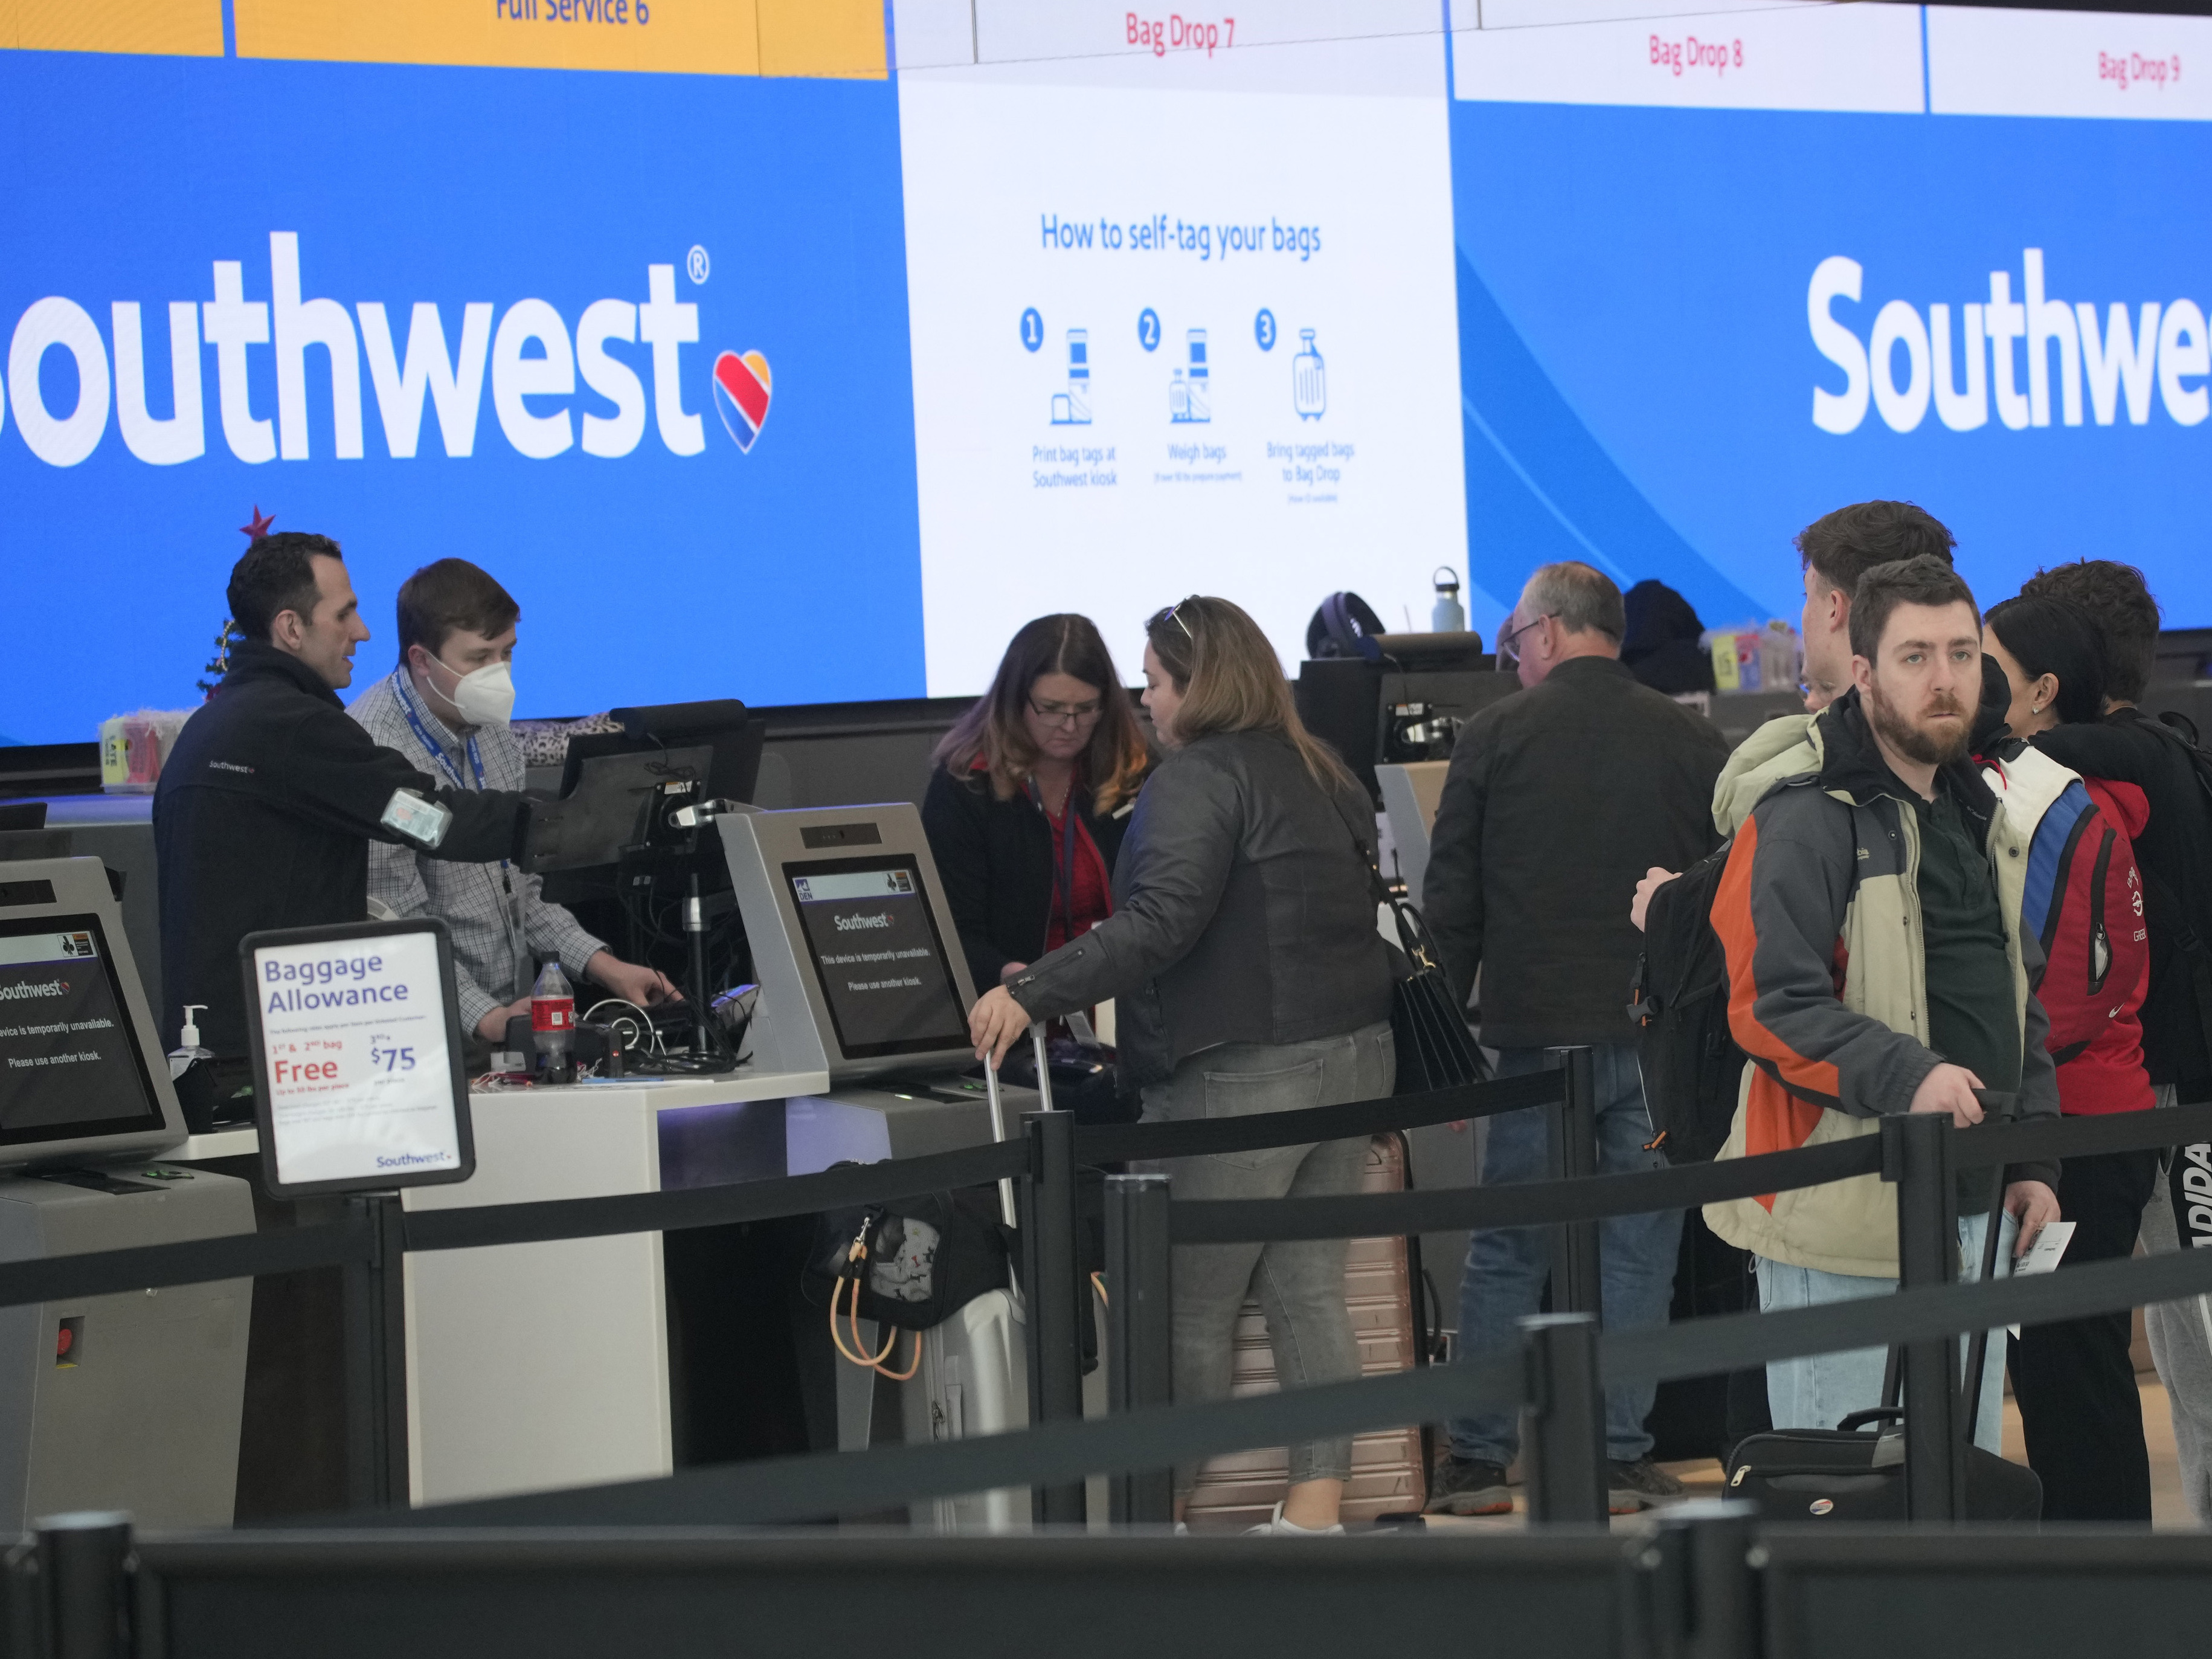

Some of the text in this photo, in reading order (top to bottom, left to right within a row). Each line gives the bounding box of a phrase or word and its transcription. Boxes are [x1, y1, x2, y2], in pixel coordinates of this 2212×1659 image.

[497, 0, 649, 25] Full Service 6
[1127, 12, 1235, 59] Bag Drop 7
[1649, 34, 1743, 77] Bag Drop 8
[2098, 51, 2181, 91] Bag Drop 9
[1041, 213, 1321, 262] How to self-tag your bags
[1026, 314, 1038, 344] 1
[1143, 315, 1156, 344] 2
[1260, 314, 1273, 344] 3
[1807, 247, 2212, 435] Southwe
[1032, 445, 1116, 468] Print bag tags at
[1166, 442, 1227, 465] Weigh bags
[1266, 440, 1355, 463] Bring tagged bags
[1032, 469, 1117, 489] Southwest kiosk
[1282, 464, 1341, 487] to Bag Drop
[209, 760, 248, 773] Southwest
[435, 752, 465, 790] Southwe
[799, 892, 813, 901] DEN
[834, 912, 889, 931] Southwest
[820, 947, 930, 965] This device is temporarily unavailable.
[265, 955, 383, 985] Baggage
[847, 981, 868, 991] Please
[881, 978, 902, 988] another
[903, 976, 922, 986] kiosk.
[268, 984, 409, 1014] Allowance
[0, 1017, 114, 1037] evice is temporarily unavailable.
[323, 1040, 343, 1051] bag
[8, 1050, 101, 1068] Please use another kiosk.
[371, 1046, 416, 1072] $75
[274, 1060, 338, 1084] Free
[376, 1152, 445, 1168] Southwest
